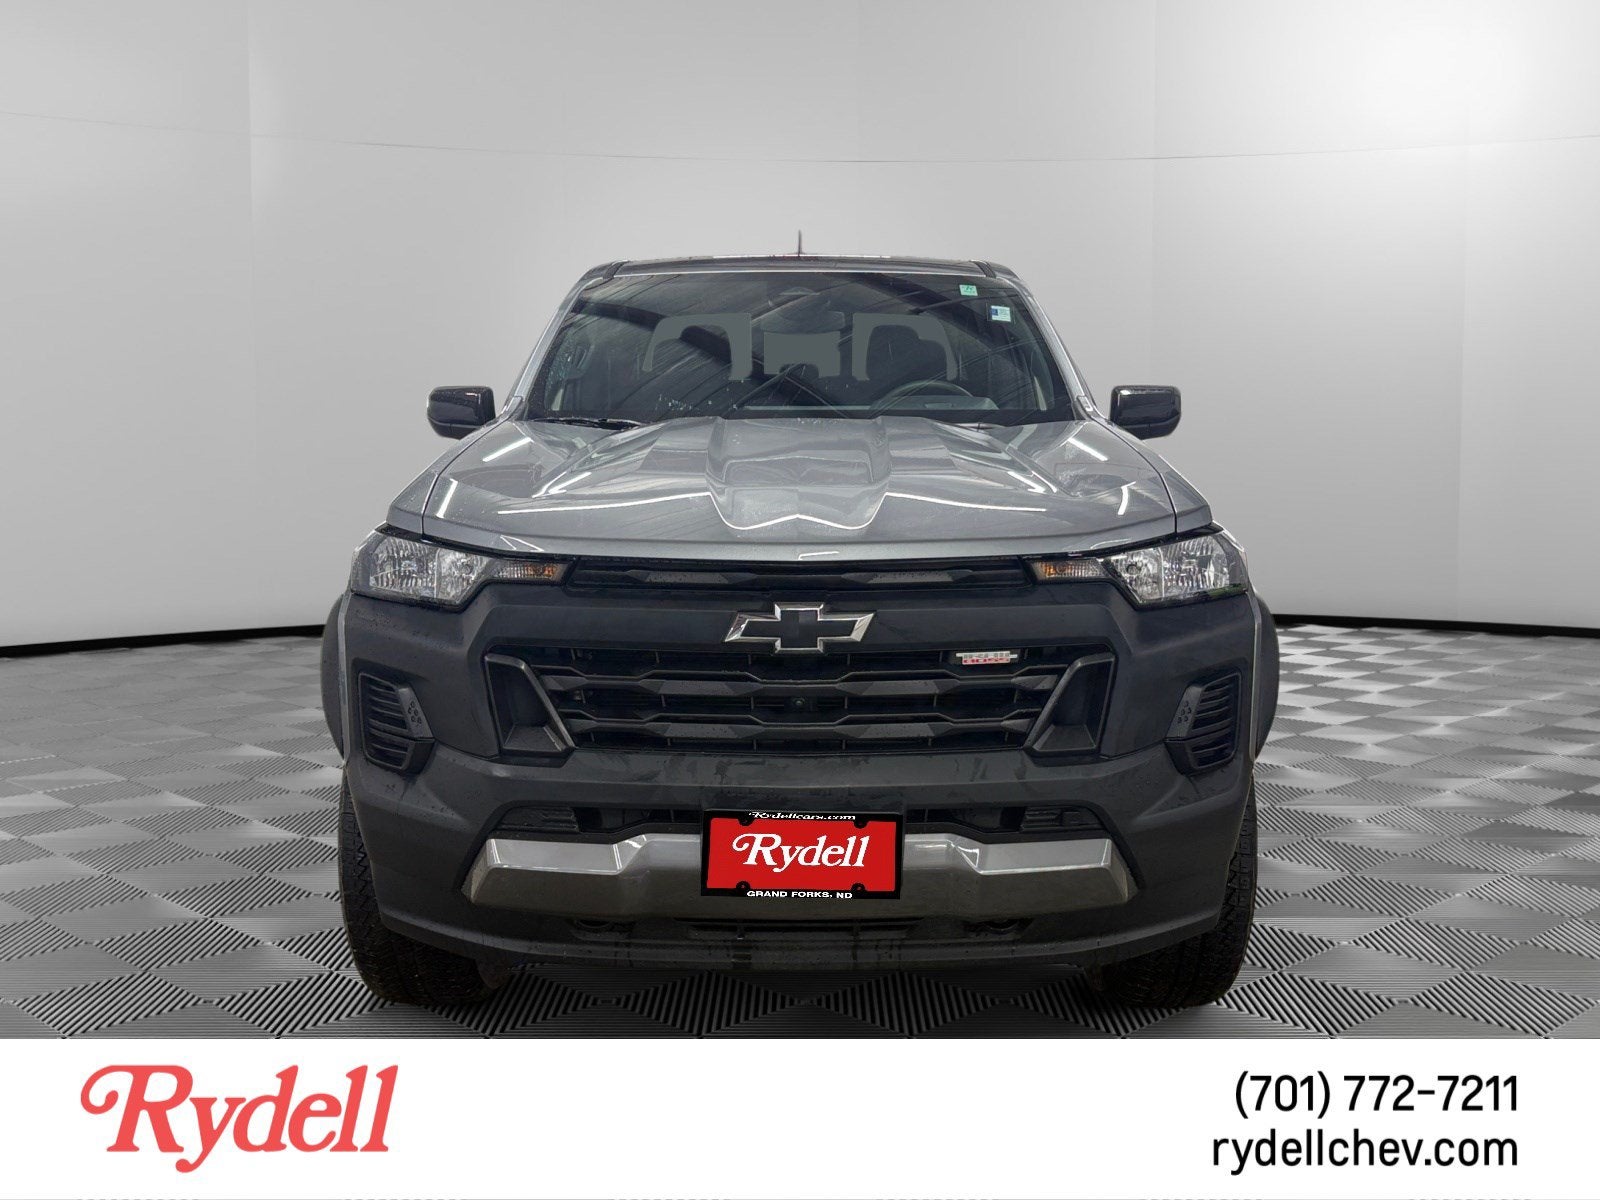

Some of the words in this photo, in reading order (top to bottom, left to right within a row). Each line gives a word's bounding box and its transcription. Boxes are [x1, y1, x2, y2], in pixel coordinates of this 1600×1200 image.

[732, 833, 870, 873] Rydell
[746, 890, 788, 898] GRAND
[791, 890, 833, 899] FORKS,
[836, 891, 853, 899] ND
